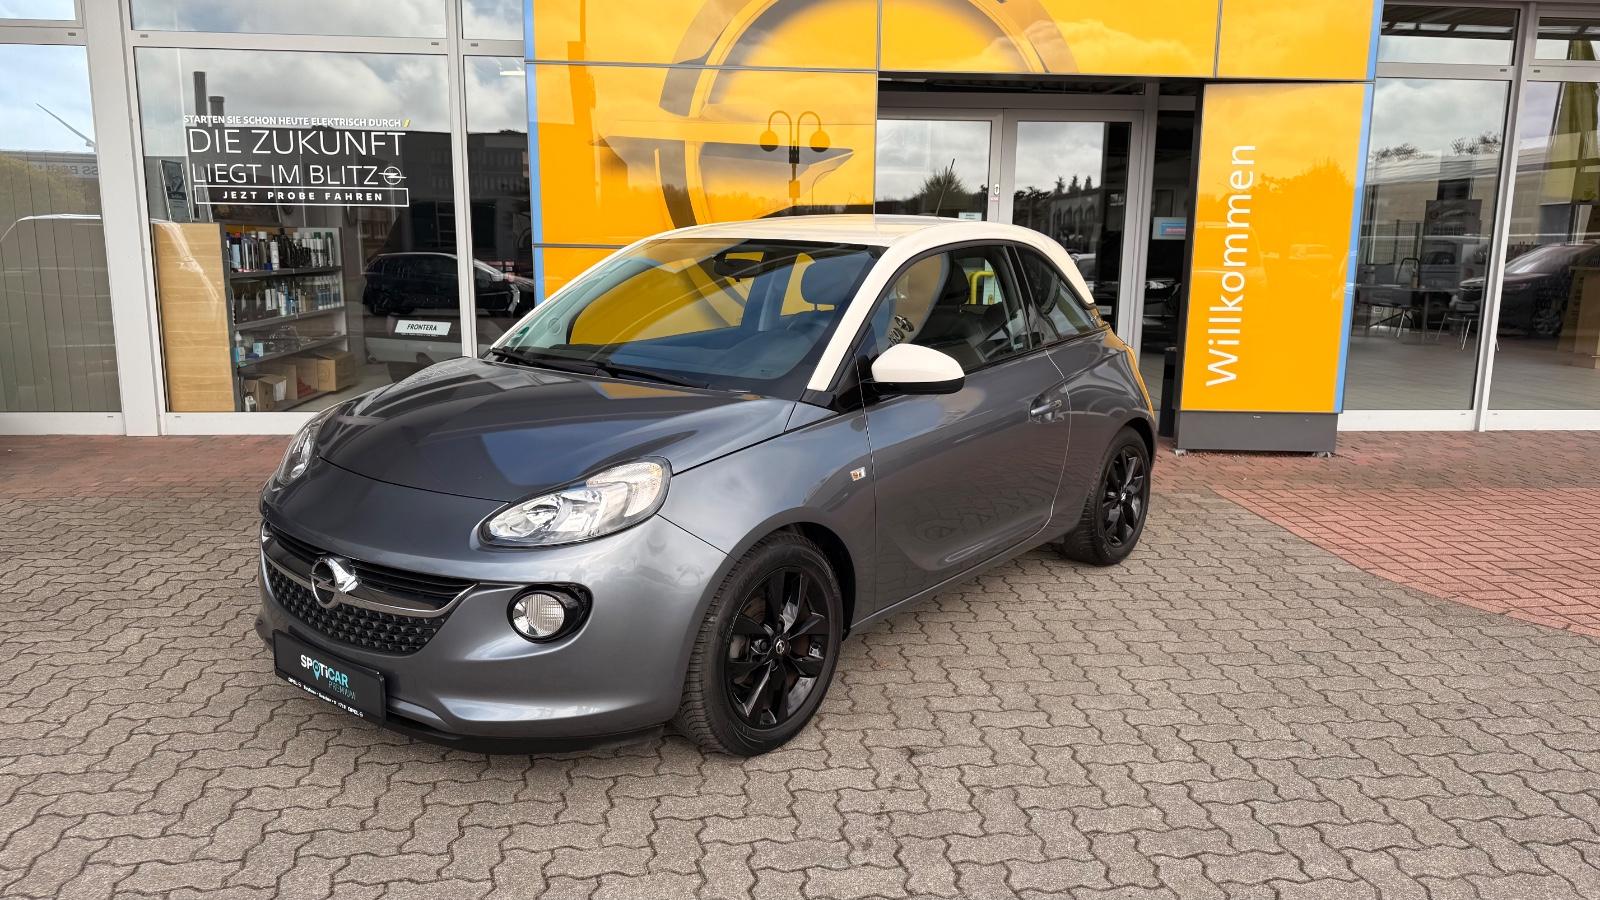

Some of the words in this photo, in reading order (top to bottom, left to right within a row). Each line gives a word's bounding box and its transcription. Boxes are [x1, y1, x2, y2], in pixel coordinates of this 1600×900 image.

[183, 114, 225, 124] STARTEN
[227, 115, 242, 125] SIE
[243, 116, 277, 125] SCHON
[279, 116, 310, 126] HEUTE
[311, 117, 367, 127] ELEKTRISCH
[369, 118, 401, 128] DURCH
[188, 129, 242, 154] DIE
[251, 129, 406, 156] ZUKUNFT
[191, 163, 262, 184] LIEGT
[271, 164, 300, 184] IM
[310, 165, 379, 185] BLITZ
[223, 191, 258, 200] JEZT
[267, 191, 315, 201] PROBE
[325, 192, 383, 202] FAHREN
[1205, 145, 1256, 387] Willkommen
[407, 323, 437, 331] FRONTERA
